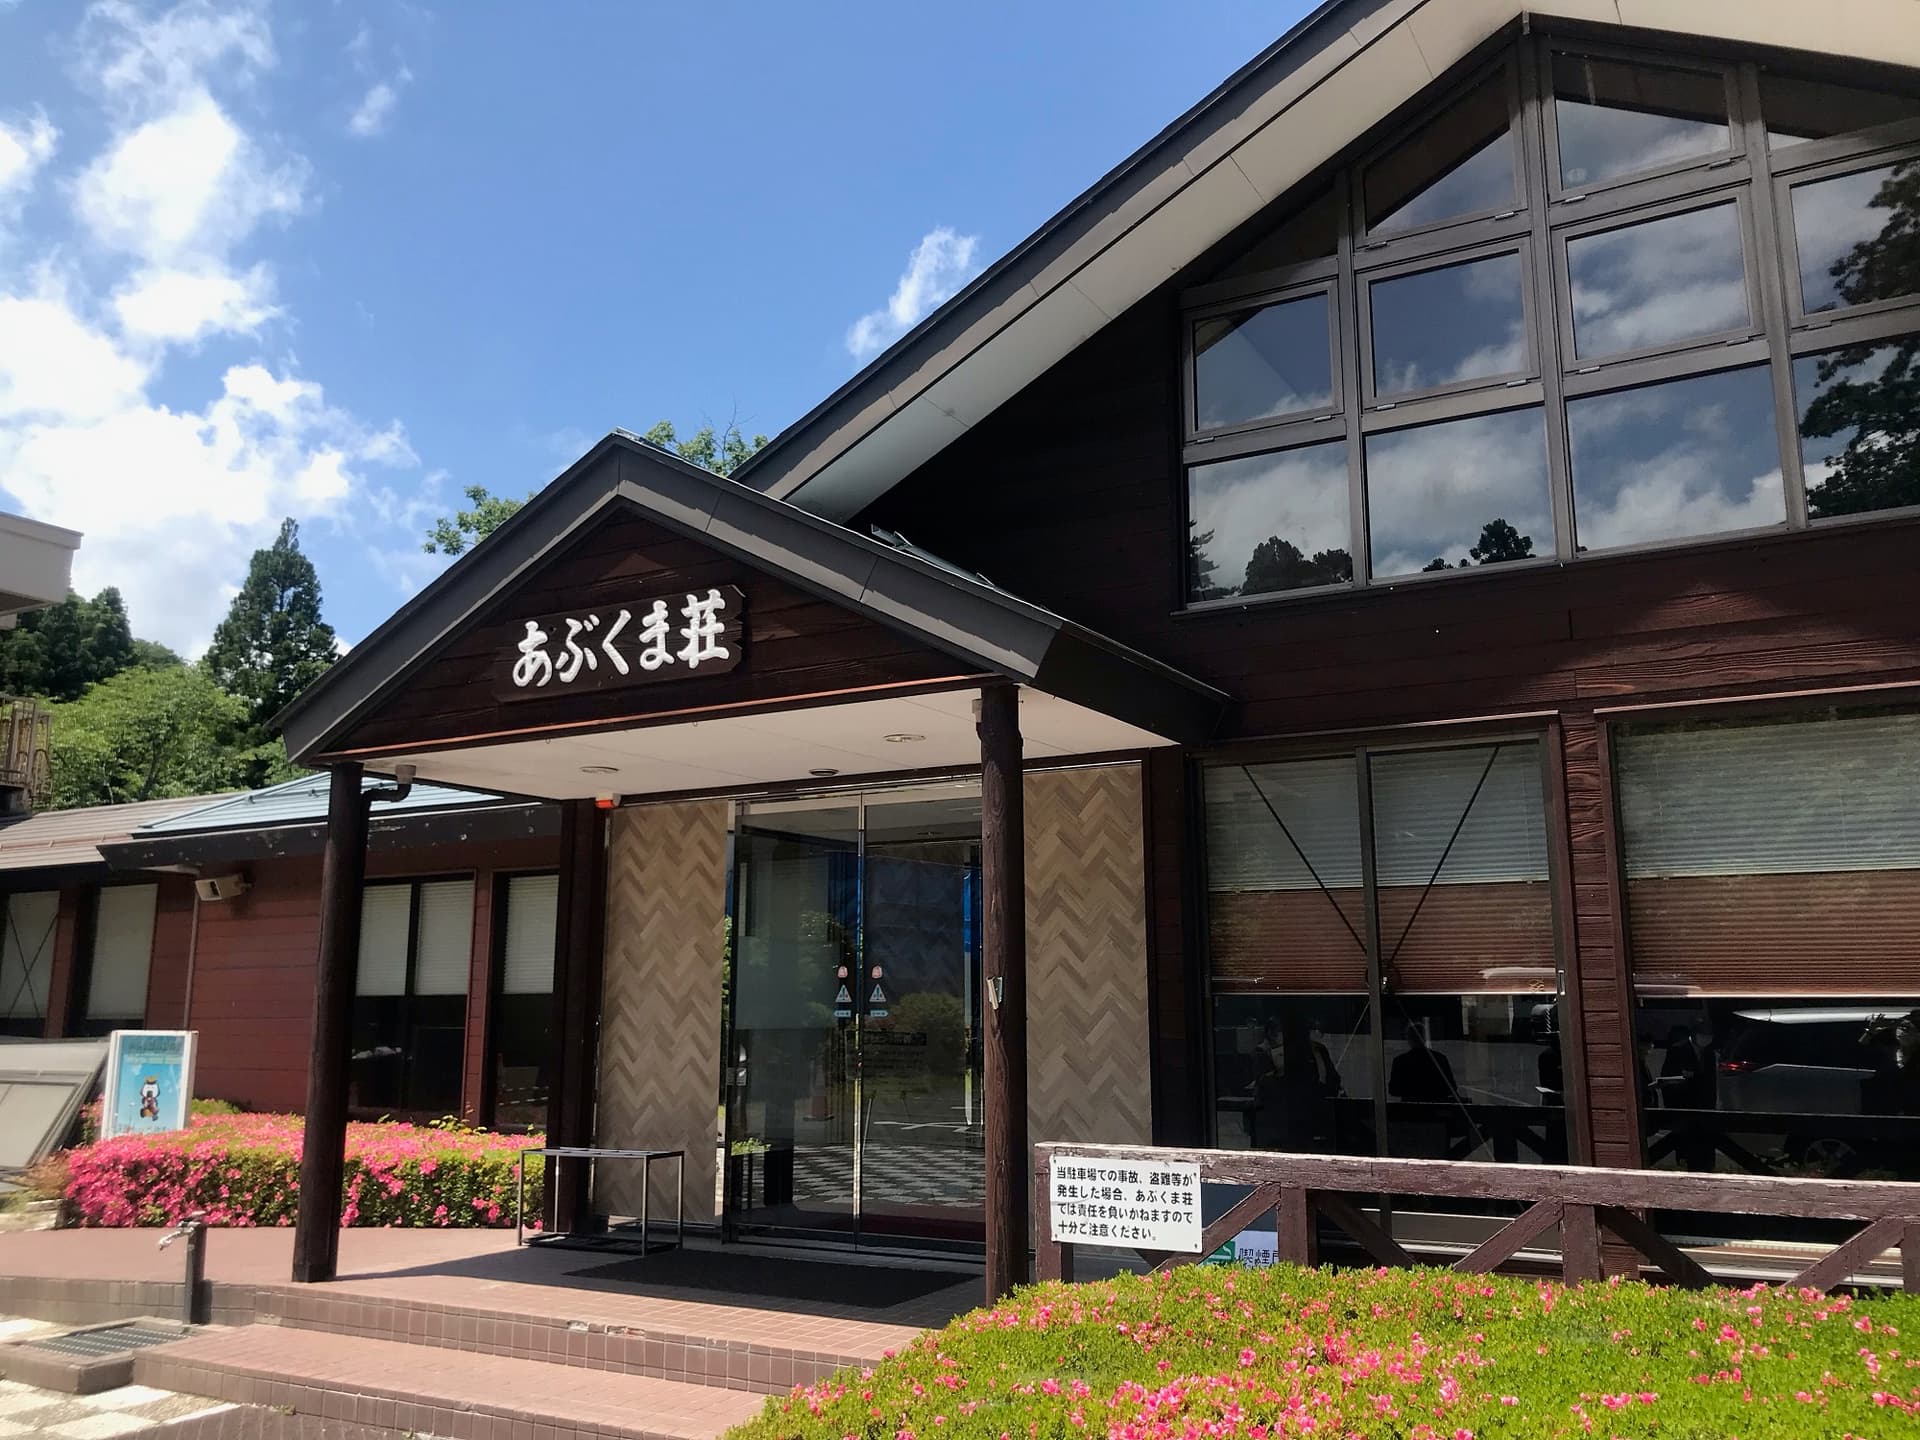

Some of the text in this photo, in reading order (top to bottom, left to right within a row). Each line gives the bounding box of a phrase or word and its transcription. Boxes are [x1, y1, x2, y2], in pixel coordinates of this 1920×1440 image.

[512, 588, 730, 687] あぶくま荘
[1056, 1166, 1194, 1187] 当駐車場での事故、盗難等が
[1056, 1184, 1194, 1206] 発生した場合、あぶくま荘
[1057, 1203, 1194, 1224] では責任を負いかねますので
[1058, 1220, 1157, 1241] 十分ご注意ください。
